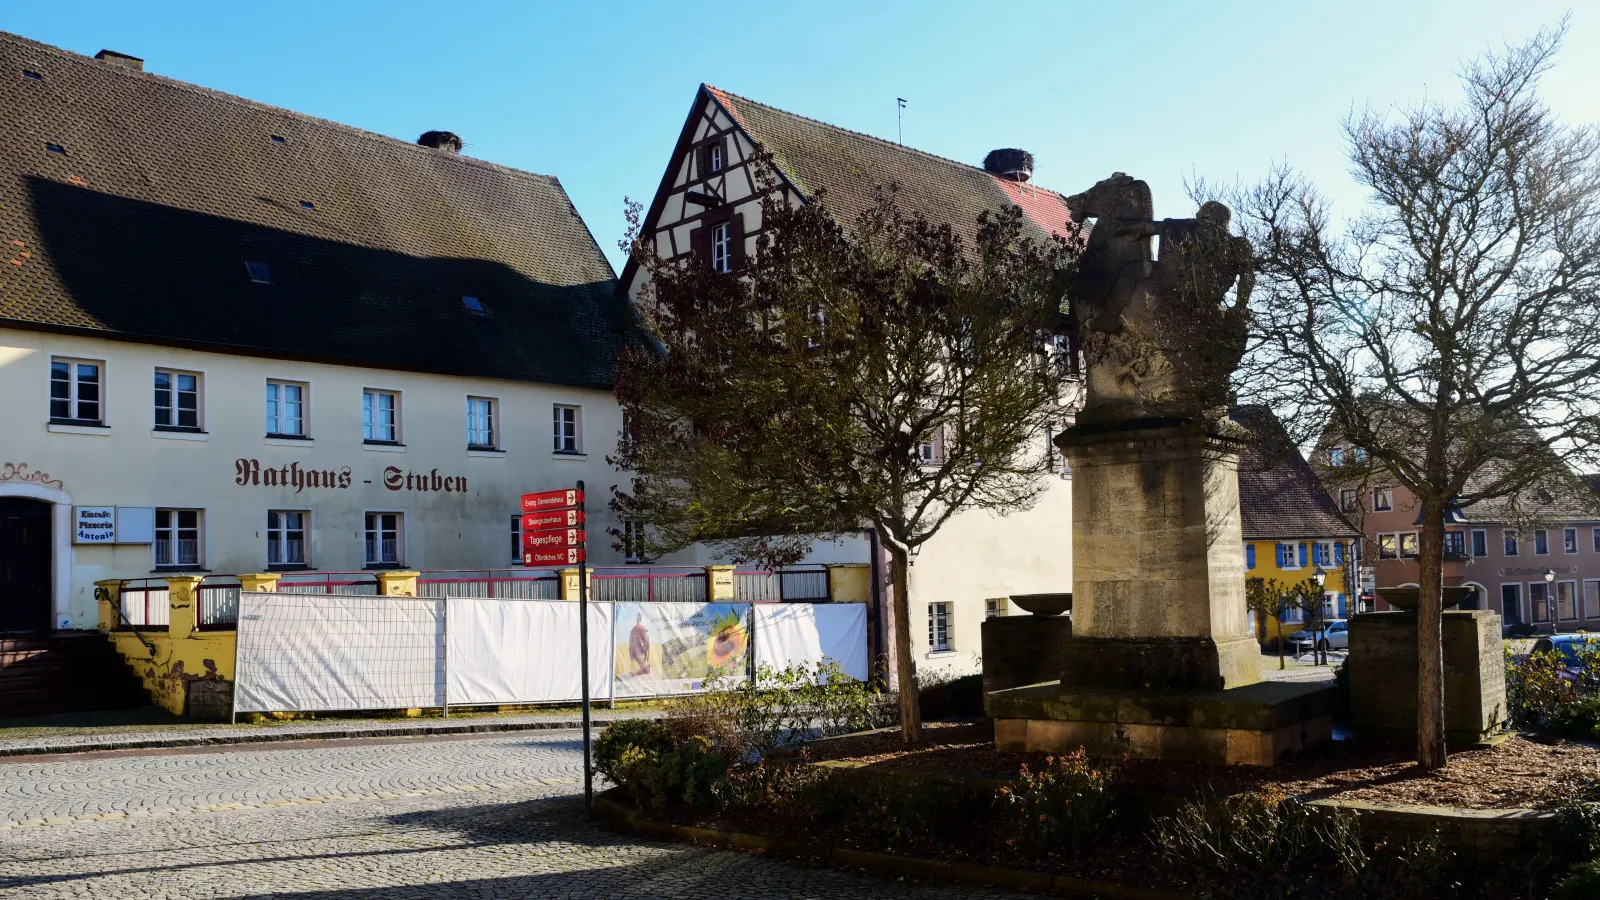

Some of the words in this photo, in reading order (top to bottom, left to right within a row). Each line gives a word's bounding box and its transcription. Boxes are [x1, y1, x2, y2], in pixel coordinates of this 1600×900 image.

[235, 458, 351, 494] Rathaus
[384, 465, 468, 493] Stuben
[537, 496, 564, 505] Gemeindehaus
[79, 521, 113, 529] Pizzeria
[78, 530, 114, 540] Antonio
[529, 535, 563, 546] Tagespflege
[534, 553, 556, 561] Öffentliches
[557, 553, 565, 561] WC
